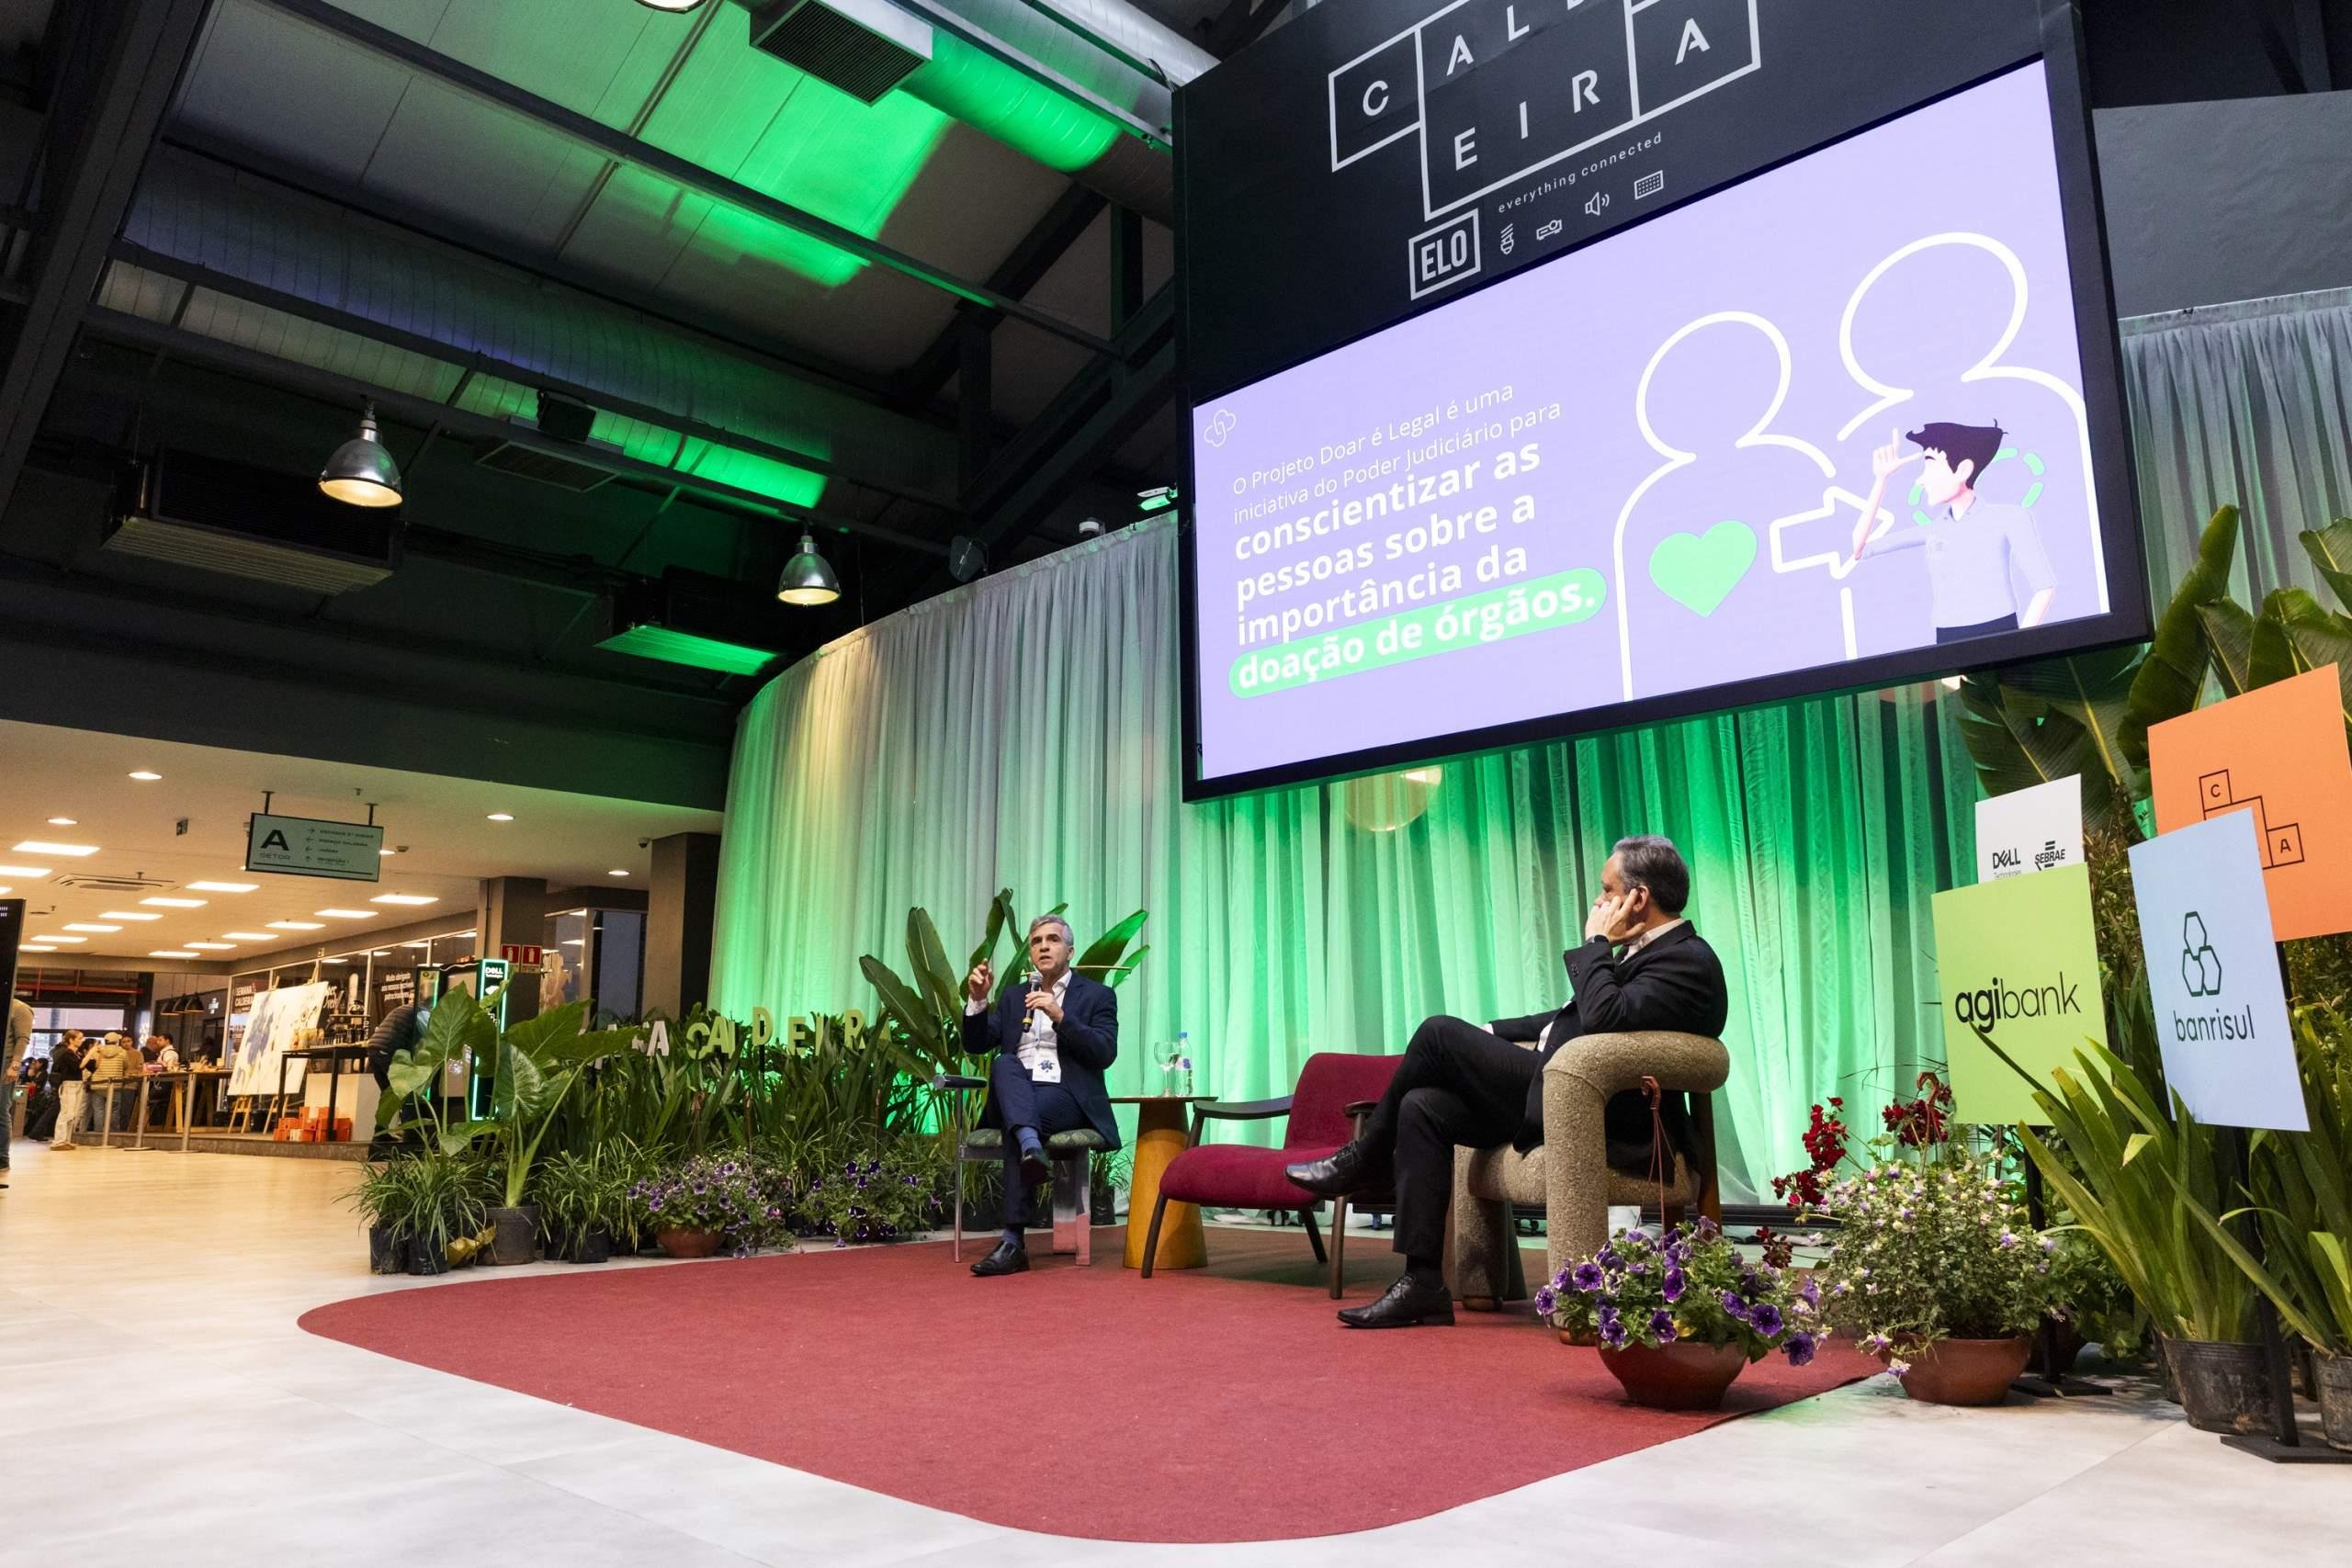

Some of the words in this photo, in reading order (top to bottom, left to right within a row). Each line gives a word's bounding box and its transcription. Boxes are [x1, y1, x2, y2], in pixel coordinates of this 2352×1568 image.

[1498, 173, 1576, 213] everything
[1581, 132, 1661, 176] connected
[1421, 230, 1467, 282] ELO
[1234, 477, 1247, 494] O
[1252, 456, 1315, 489] Projeto
[1320, 436, 1365, 465] Doar
[1371, 426, 1383, 446] é
[1389, 405, 1440, 441] Legal
[1446, 399, 1458, 420] é
[1465, 384, 1513, 413] uma
[1234, 489, 1308, 525] iniciativa
[1314, 478, 1338, 497] do
[1343, 456, 1401, 487] Poder
[1405, 423, 1503, 471] Judiciário
[1510, 402, 1561, 438] para
[1235, 460, 1481, 559] conscientizar
[1493, 442, 1541, 479] as
[1237, 540, 1374, 611] pessoas
[1385, 506, 1498, 559] sobre
[1511, 494, 1535, 525] a
[1238, 561, 1462, 646] importância
[1476, 545, 1528, 582] da
[1238, 636, 1364, 683] doação
[1375, 619, 1423, 656] de
[1435, 581, 1595, 642] órgãos.
[260, 829, 289, 851] A
[1992, 848, 2021, 869] DELL
[2034, 849, 2065, 863] SEBRAE
[1956, 972, 2081, 1032] agibank
[2173, 1005, 2255, 1042] banrisul
